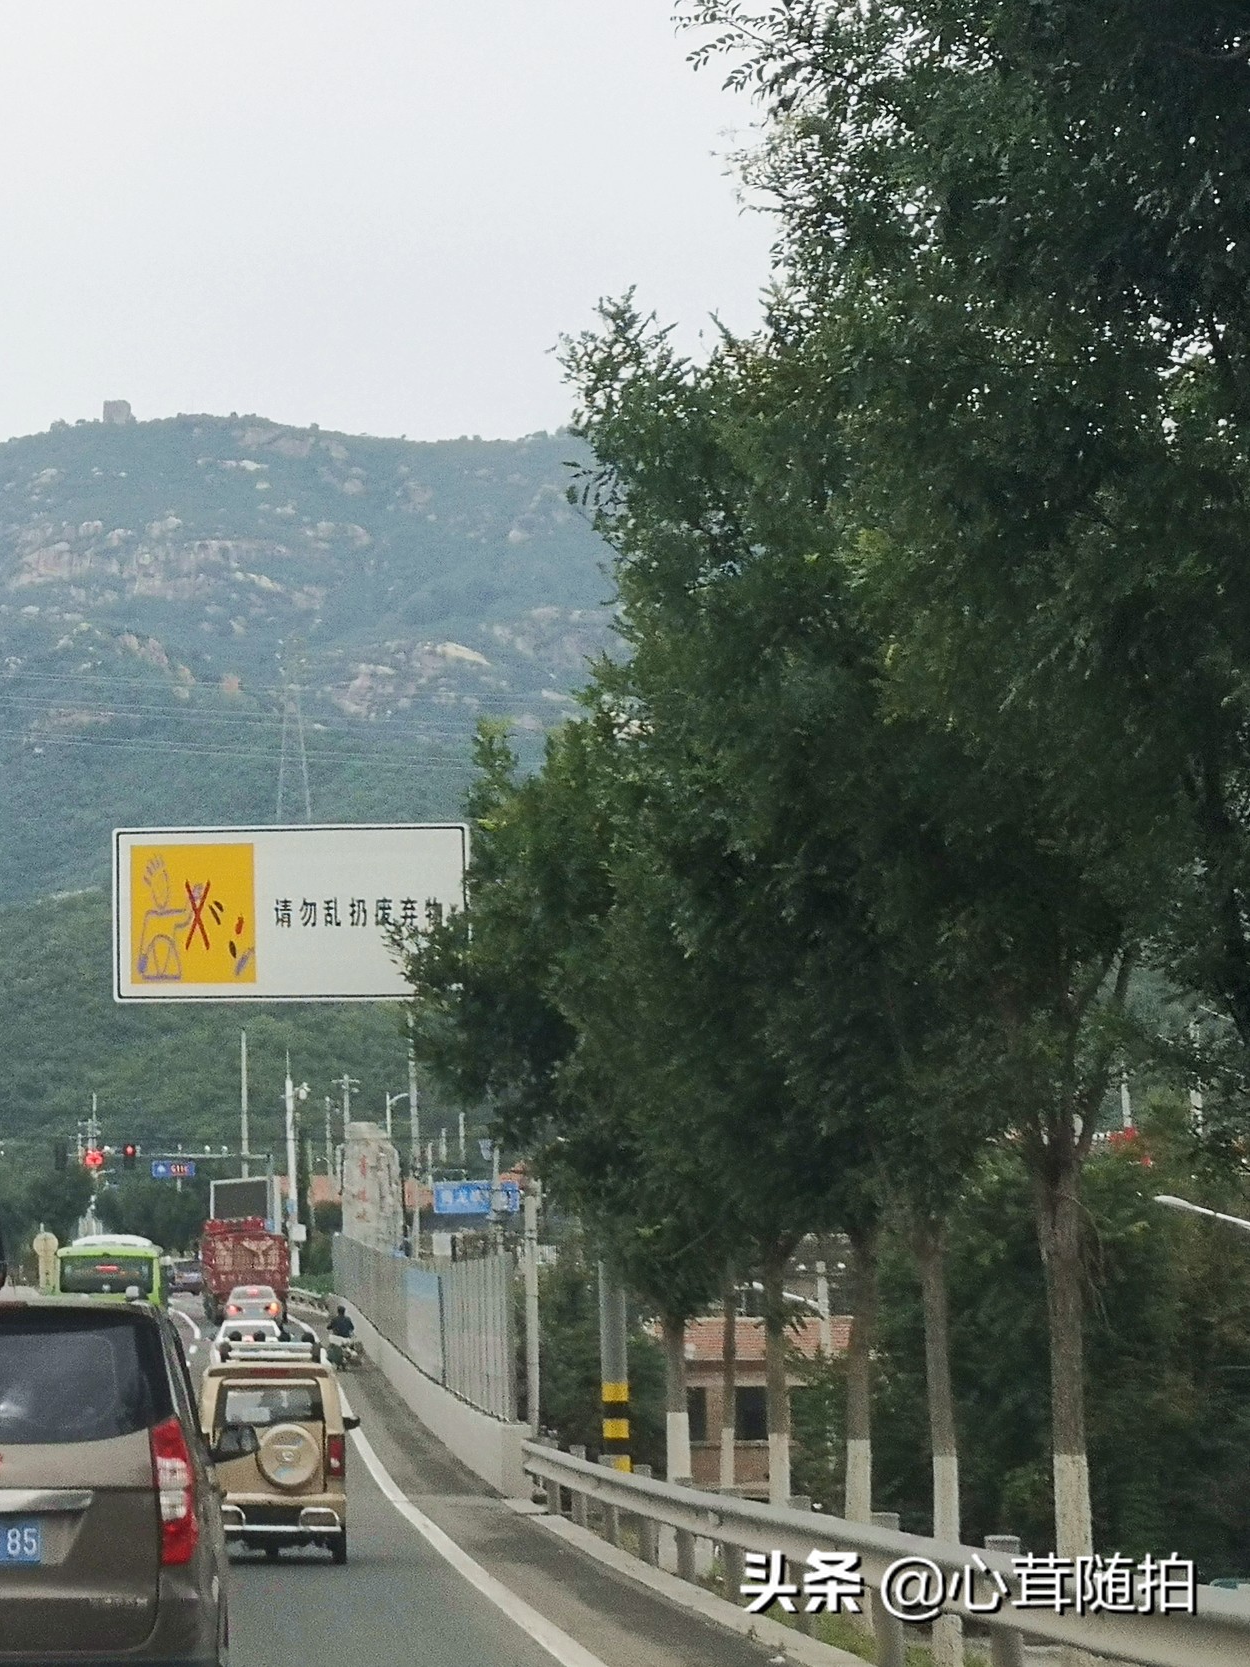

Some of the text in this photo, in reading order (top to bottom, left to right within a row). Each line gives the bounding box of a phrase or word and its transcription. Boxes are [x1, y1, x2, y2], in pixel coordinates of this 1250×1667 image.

[275, 898, 443, 928] 请勿乱扔废弃物
